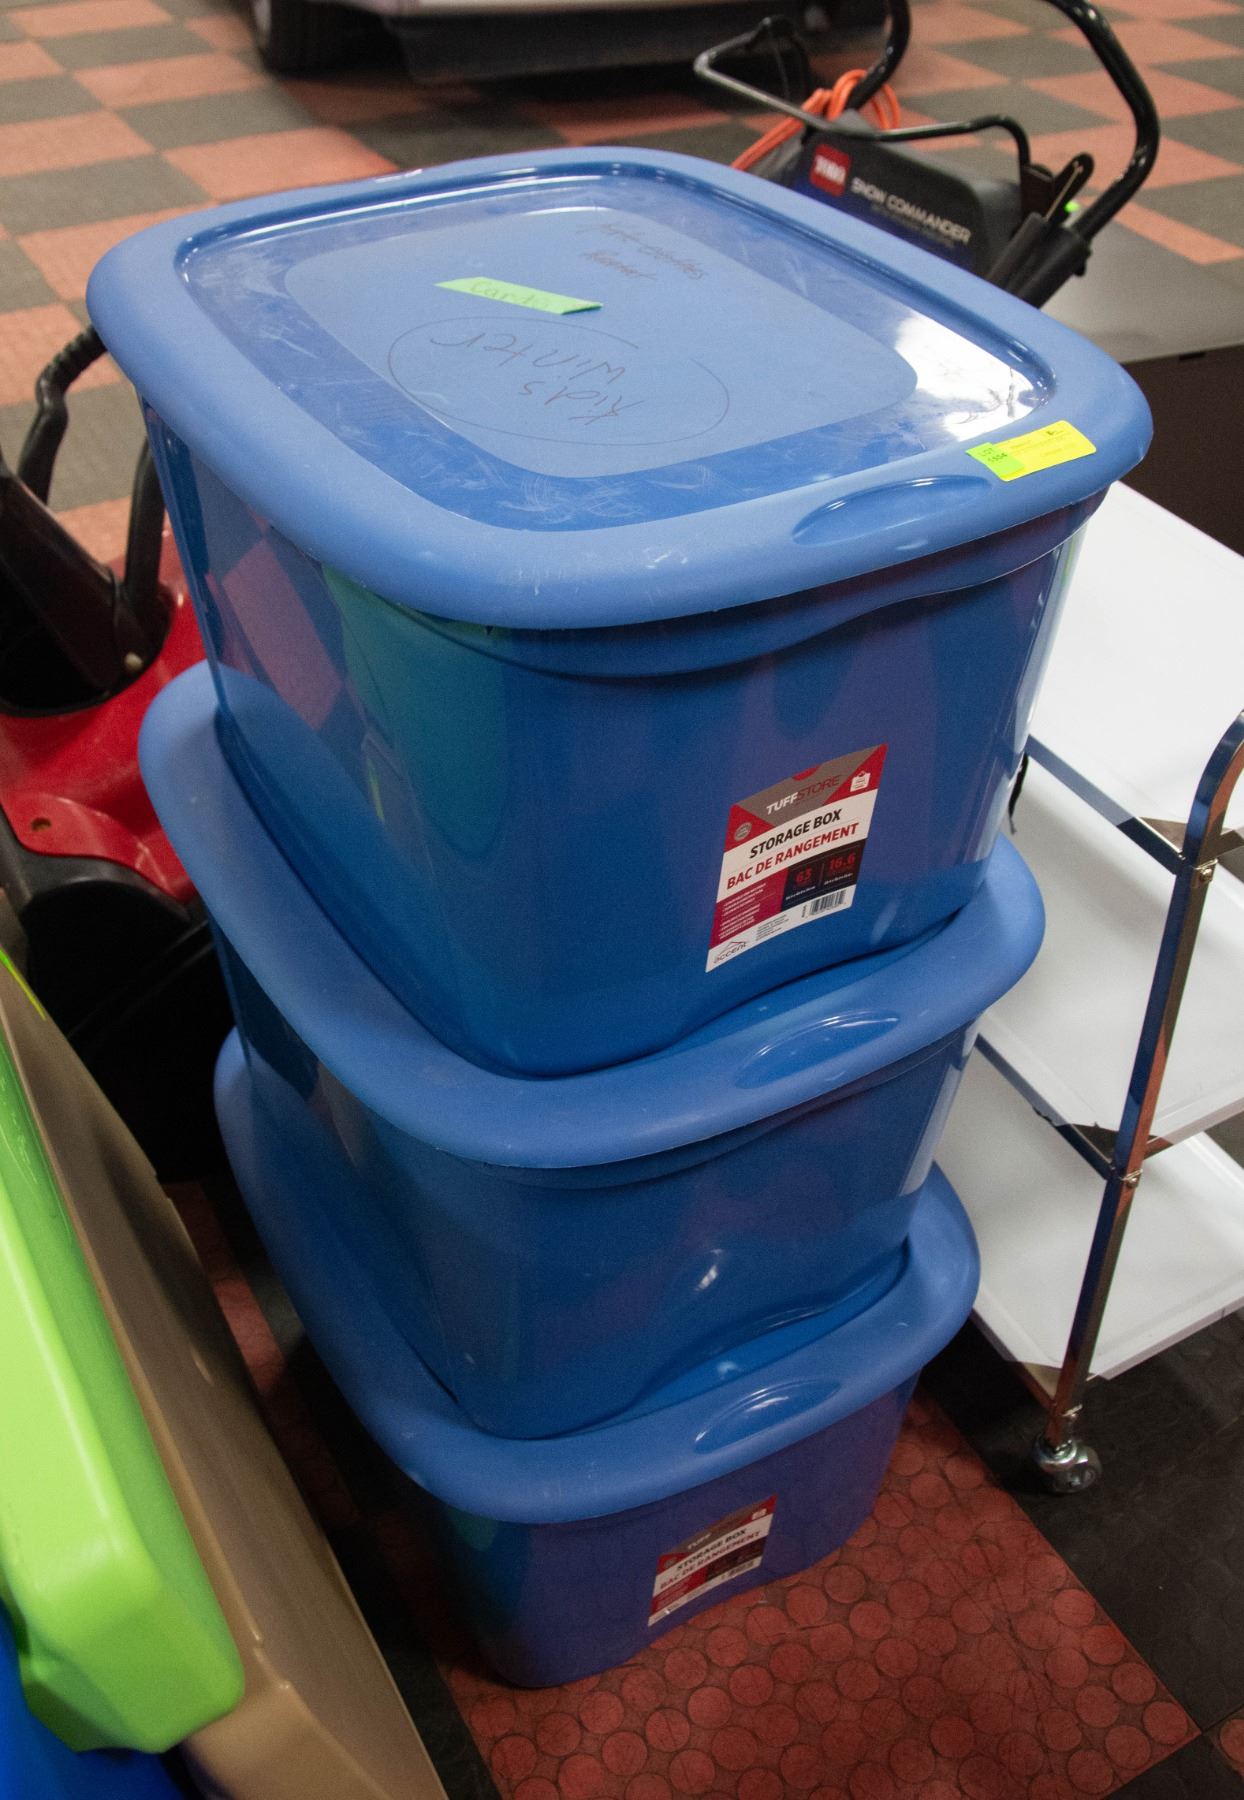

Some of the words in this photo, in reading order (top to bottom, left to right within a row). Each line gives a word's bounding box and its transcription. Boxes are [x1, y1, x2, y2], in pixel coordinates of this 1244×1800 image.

[886, 194, 971, 244] COMMANDER
[430, 333, 626, 384] Winter
[766, 775, 841, 815] TUFFSTORE
[726, 866, 753, 890] BAC
[755, 858, 773, 874] DE
[775, 823, 859, 865] RANGEMENT
[749, 816, 811, 859] STORAGE
[813, 809, 842, 829] BOX
